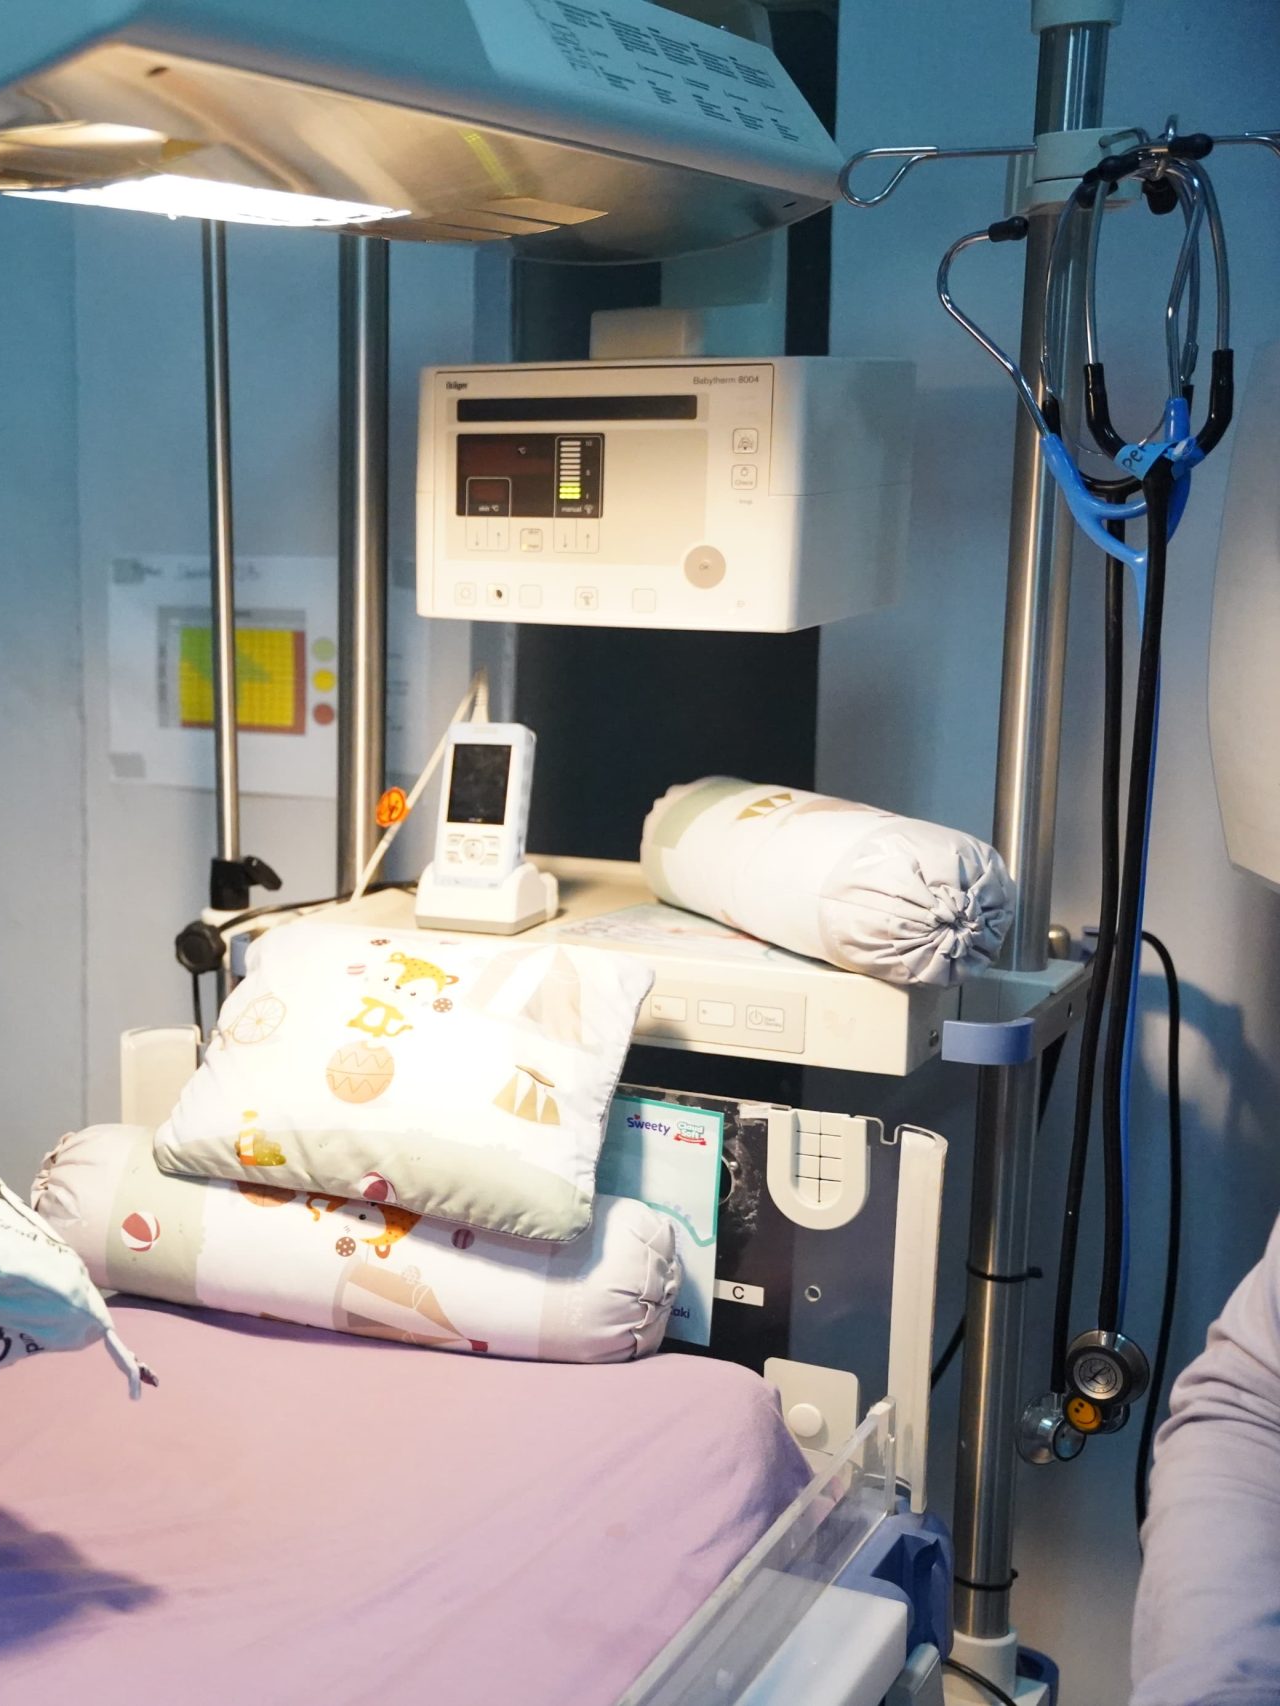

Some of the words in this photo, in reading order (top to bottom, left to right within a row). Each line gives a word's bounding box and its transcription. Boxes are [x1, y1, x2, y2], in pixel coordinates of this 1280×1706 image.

[692, 375, 736, 387] Babytherm
[737, 375, 760, 385] 8004
[626, 1116, 671, 1136] Sweety
[732, 1285, 745, 1300] C
